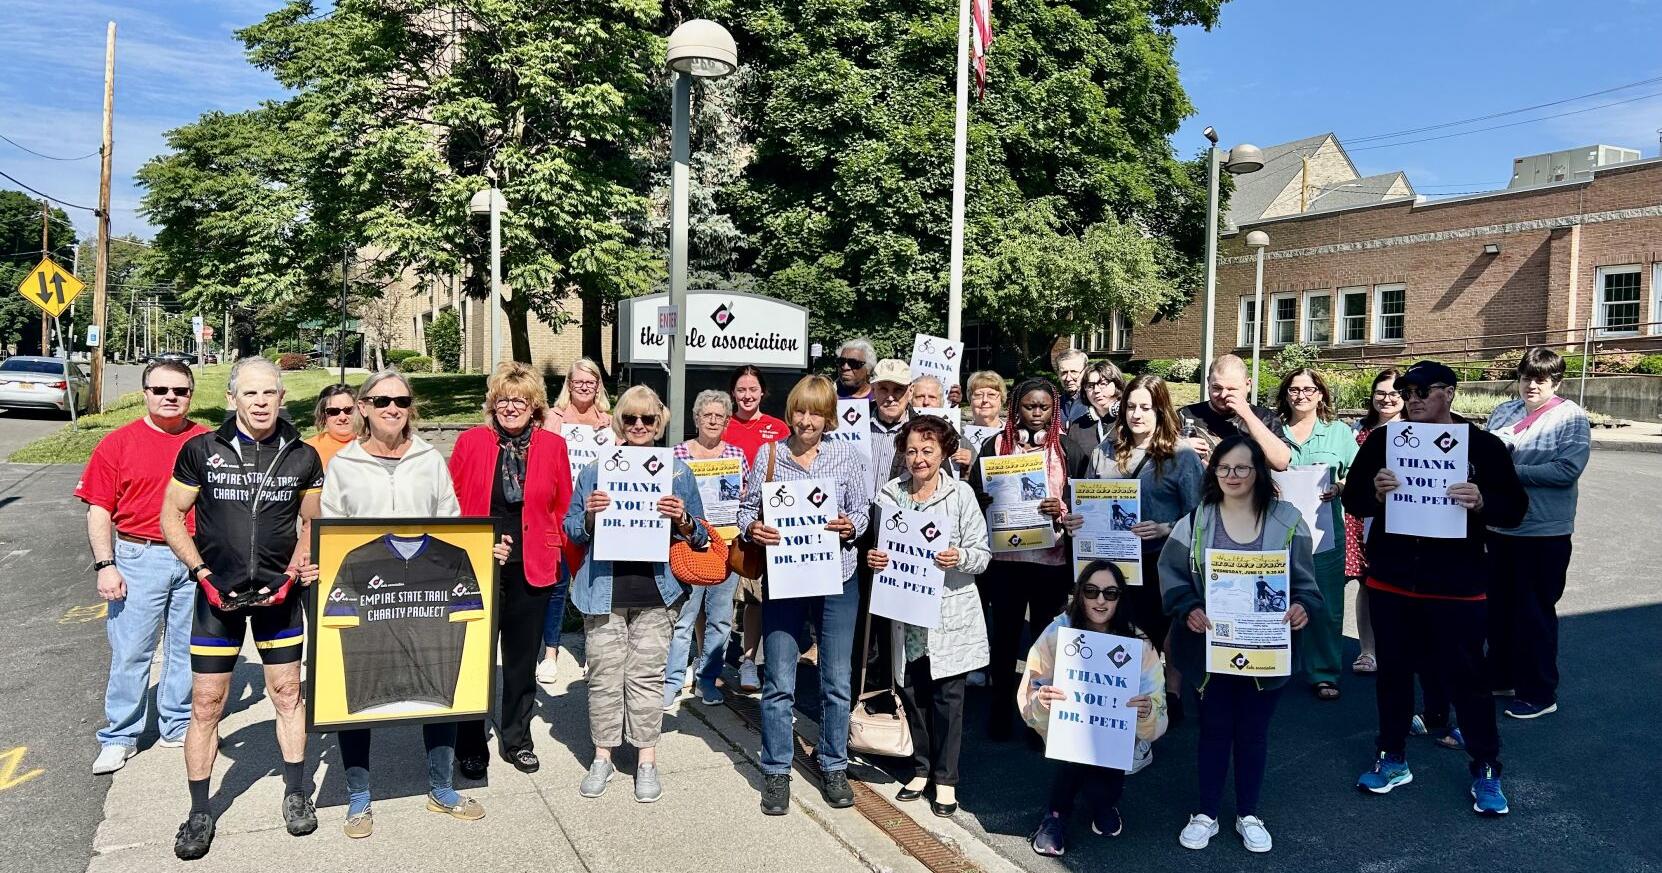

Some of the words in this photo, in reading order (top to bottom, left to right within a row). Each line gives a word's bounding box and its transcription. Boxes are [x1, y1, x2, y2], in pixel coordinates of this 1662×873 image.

[659, 312, 678, 328] ENTER
[640, 326, 664, 346] the
[712, 331, 799, 351] association
[918, 359, 953, 372] THANK
[568, 449, 597, 458] THAN
[1397, 457, 1456, 470] THANK
[207, 471, 241, 485] EMPIRE
[1405, 476, 1437, 488] YOU
[1443, 479, 1447, 488] !
[213, 487, 249, 501] CHARITY
[260, 490, 293, 501] PROJECT
[608, 481, 661, 493] THANK
[615, 500, 645, 511] YOU
[649, 501, 653, 512] !
[1393, 493, 1417, 503] DR.
[1421, 495, 1459, 506] PETE
[603, 518, 625, 528] DR.
[630, 519, 664, 529] PETE
[774, 514, 828, 528] THANK
[784, 534, 813, 546] YOU
[818, 534, 821, 543] !
[886, 540, 936, 560] THANK
[774, 555, 797, 564] DR.
[801, 552, 834, 562] PETE
[892, 559, 919, 575] YOU
[923, 567, 927, 577] !
[879, 575, 899, 587] DR.
[904, 581, 936, 596] PETE
[360, 592, 396, 606] EMPIRE
[398, 590, 422, 603] STATE
[424, 590, 449, 602] TRAIL
[367, 607, 406, 621] CHARITY
[407, 606, 445, 617] PROJECT
[1066, 668, 1128, 689] THANK
[1073, 691, 1107, 706] YOU
[1112, 697, 1117, 708] !
[1058, 710, 1083, 723] DR.
[1089, 715, 1128, 731] PETE
